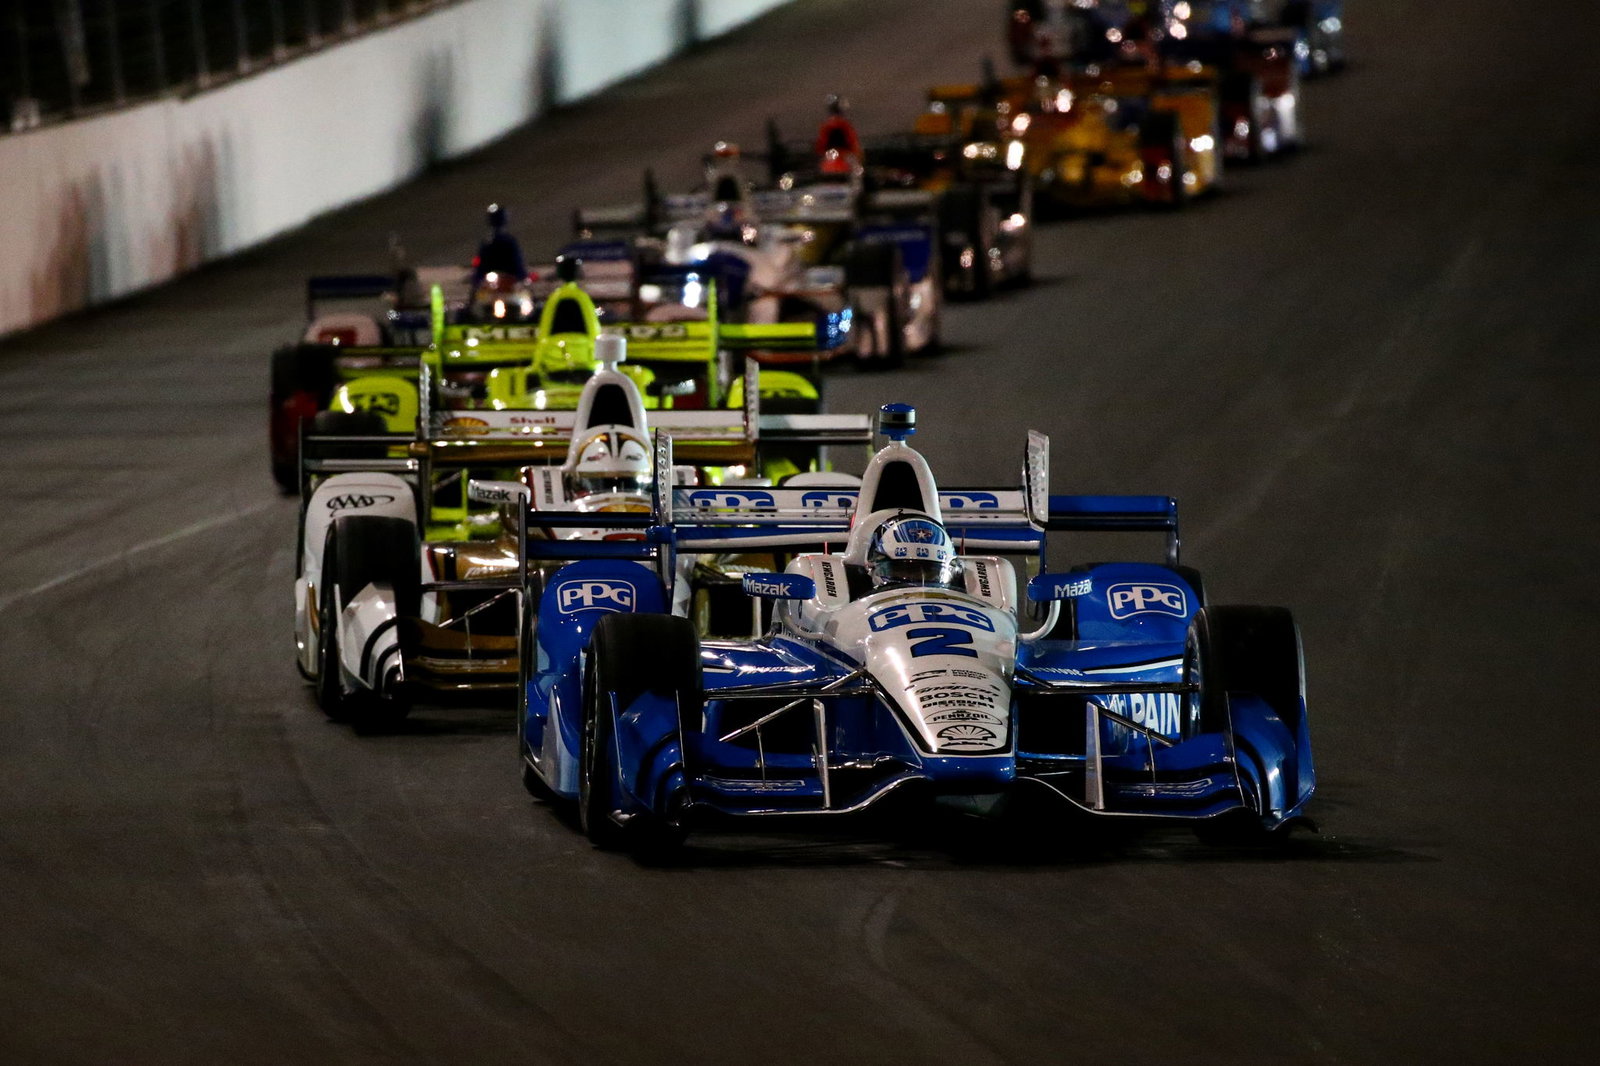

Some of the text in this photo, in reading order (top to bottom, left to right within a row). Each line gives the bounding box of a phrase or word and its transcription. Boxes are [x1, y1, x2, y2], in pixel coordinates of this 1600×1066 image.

[510, 416, 556, 425] Shell
[804, 493, 858, 507] PP
[744, 579, 792, 596] Mazak
[821, 561, 838, 598] NEWGARDEN
[975, 560, 992, 598] NEWGARDEN
[562, 583, 631, 606] PPG
[1112, 585, 1183, 610] PPG
[873, 604, 991, 629] PPG
[906, 627, 979, 658] 2
[919, 692, 994, 703] BOSCH
[932, 713, 992, 722] PENNZOIL
